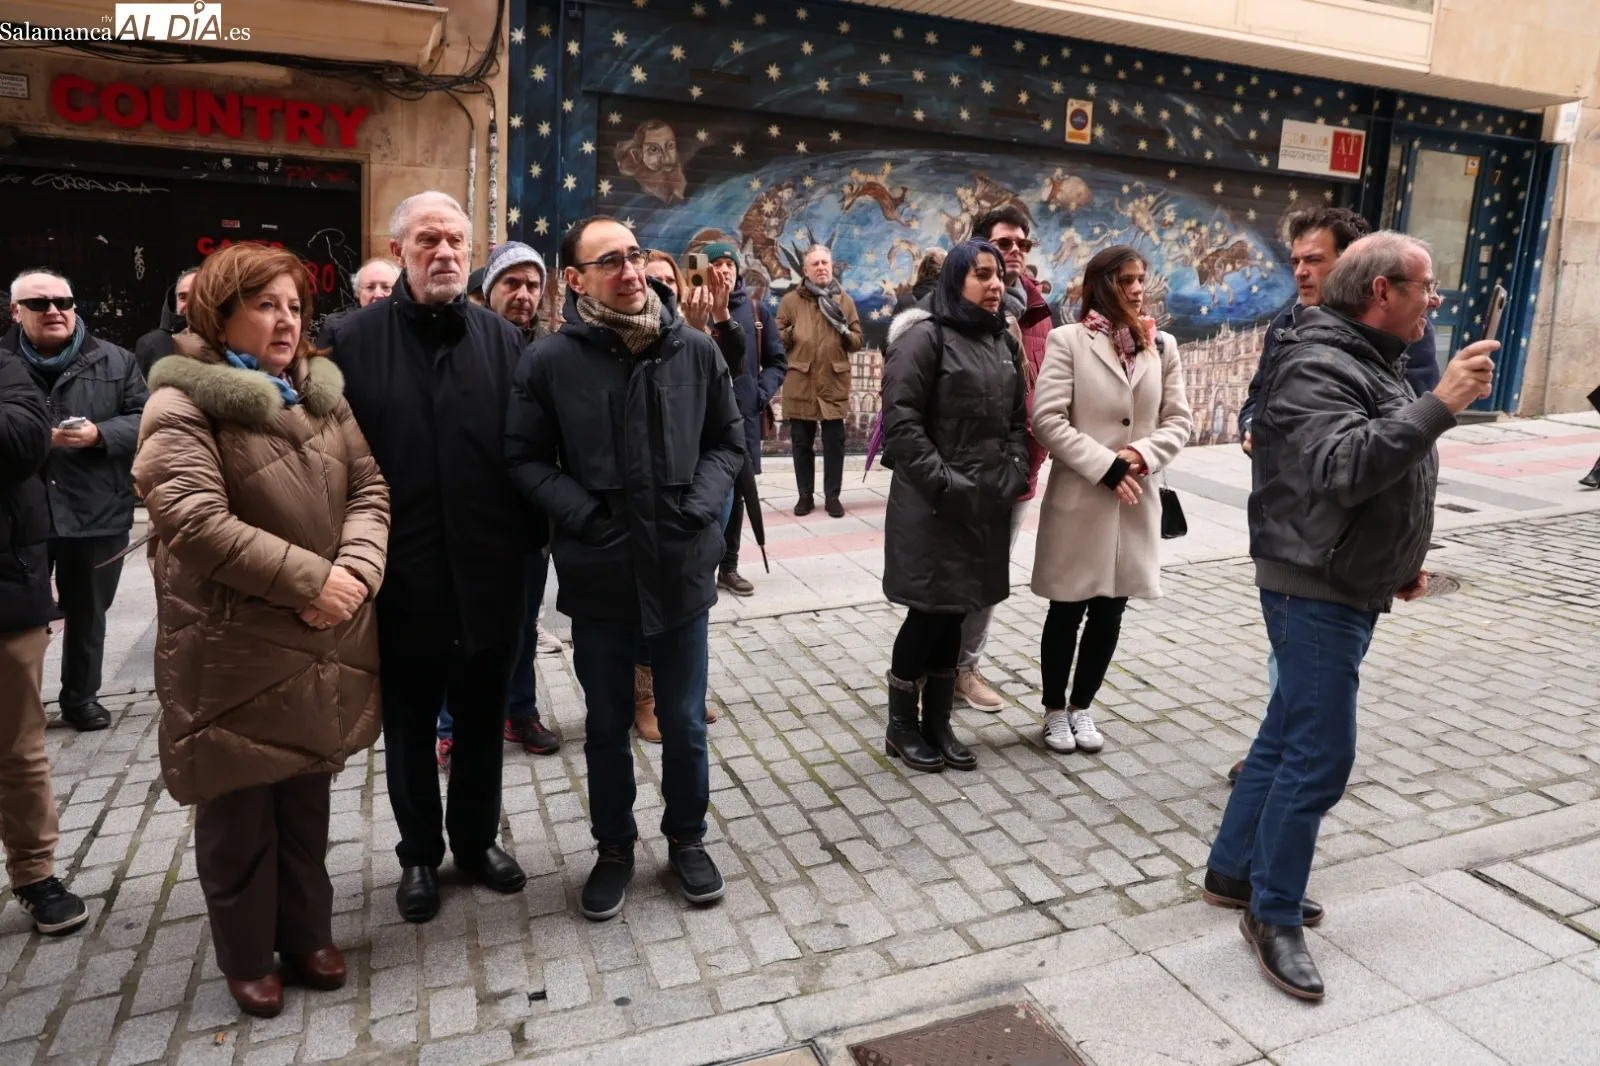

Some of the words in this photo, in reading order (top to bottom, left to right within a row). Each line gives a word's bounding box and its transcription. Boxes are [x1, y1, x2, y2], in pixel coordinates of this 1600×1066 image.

[52, 74, 367, 147] COUNTRY
[1336, 134, 1359, 156] AT
[1493, 170, 1501, 185] 7
